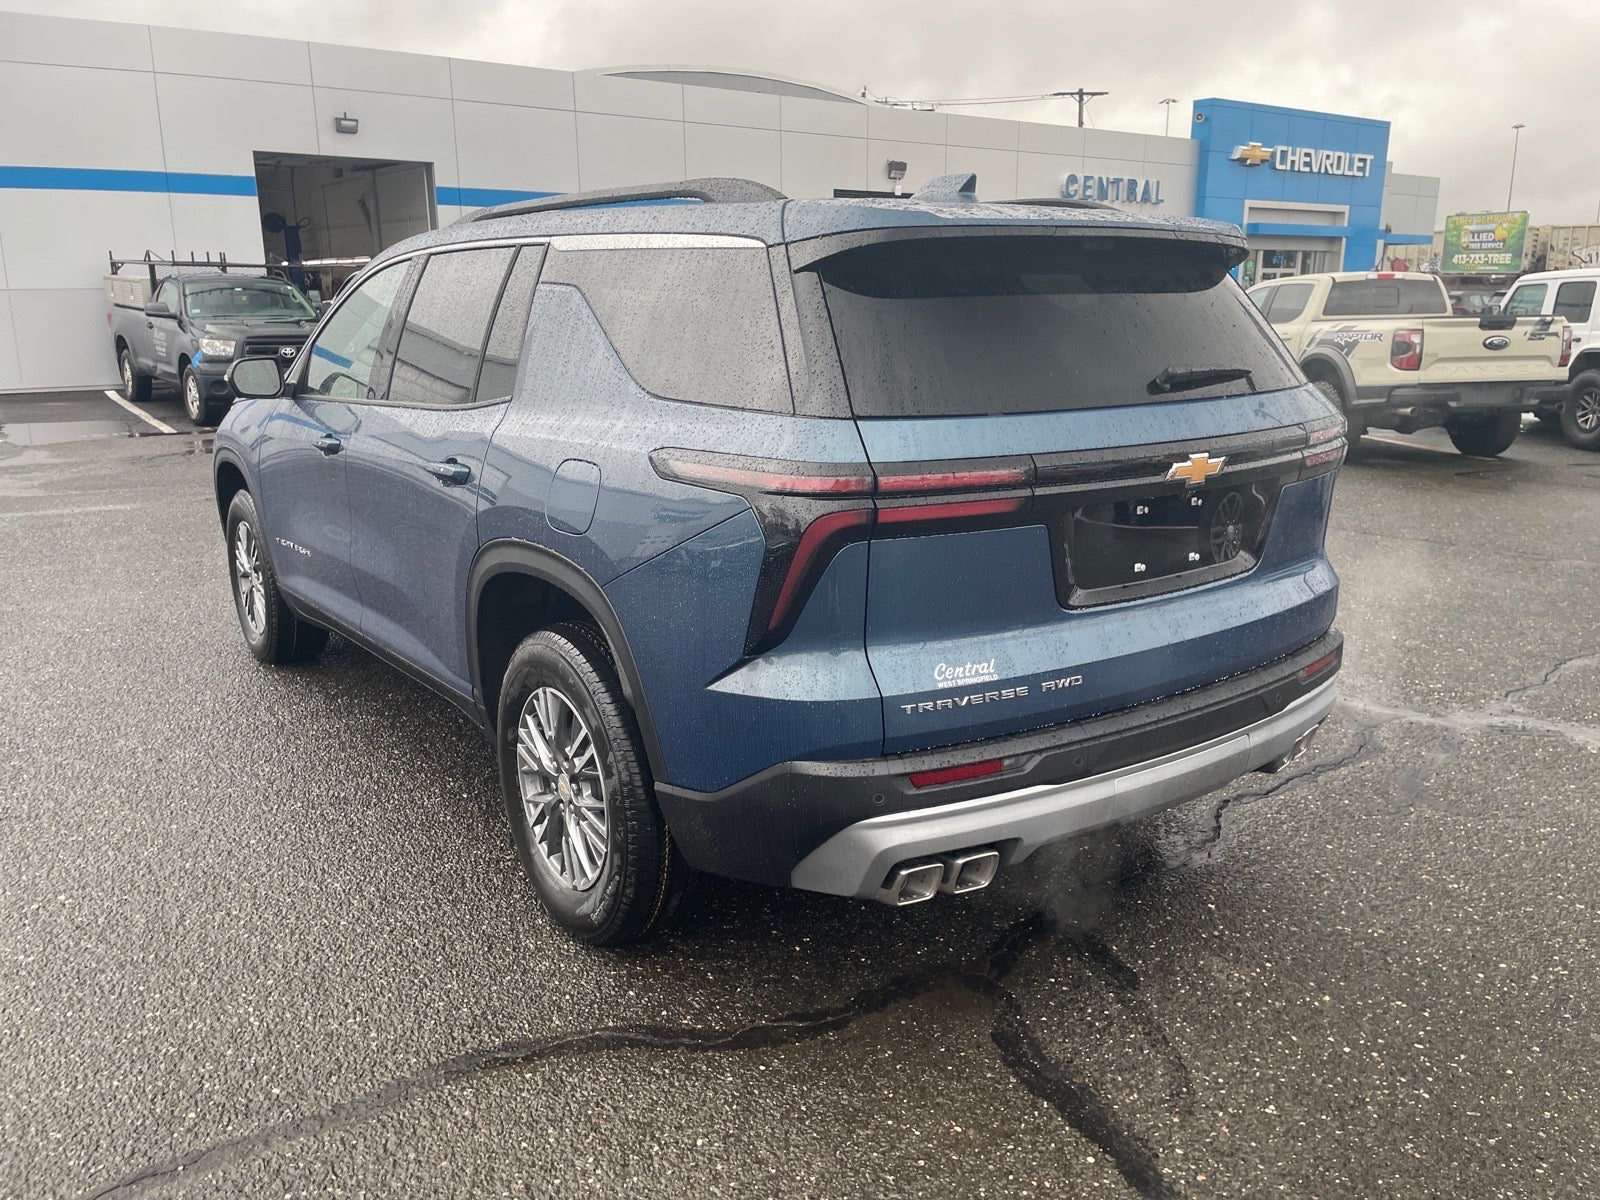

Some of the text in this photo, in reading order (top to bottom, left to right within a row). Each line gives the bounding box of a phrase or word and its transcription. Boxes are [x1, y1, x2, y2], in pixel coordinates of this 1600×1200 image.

[1273, 145, 1374, 178] CHEVROLET
[1062, 172, 1164, 204] CENTRAL
[1452, 253, 1512, 265] 413-733-TREE
[1334, 332, 1384, 345] RAPTOR
[934, 658, 995, 680] Central
[936, 674, 999, 689] WEST SPRINGFIELD
[900, 675, 1083, 715] TRAVERSE AWD
